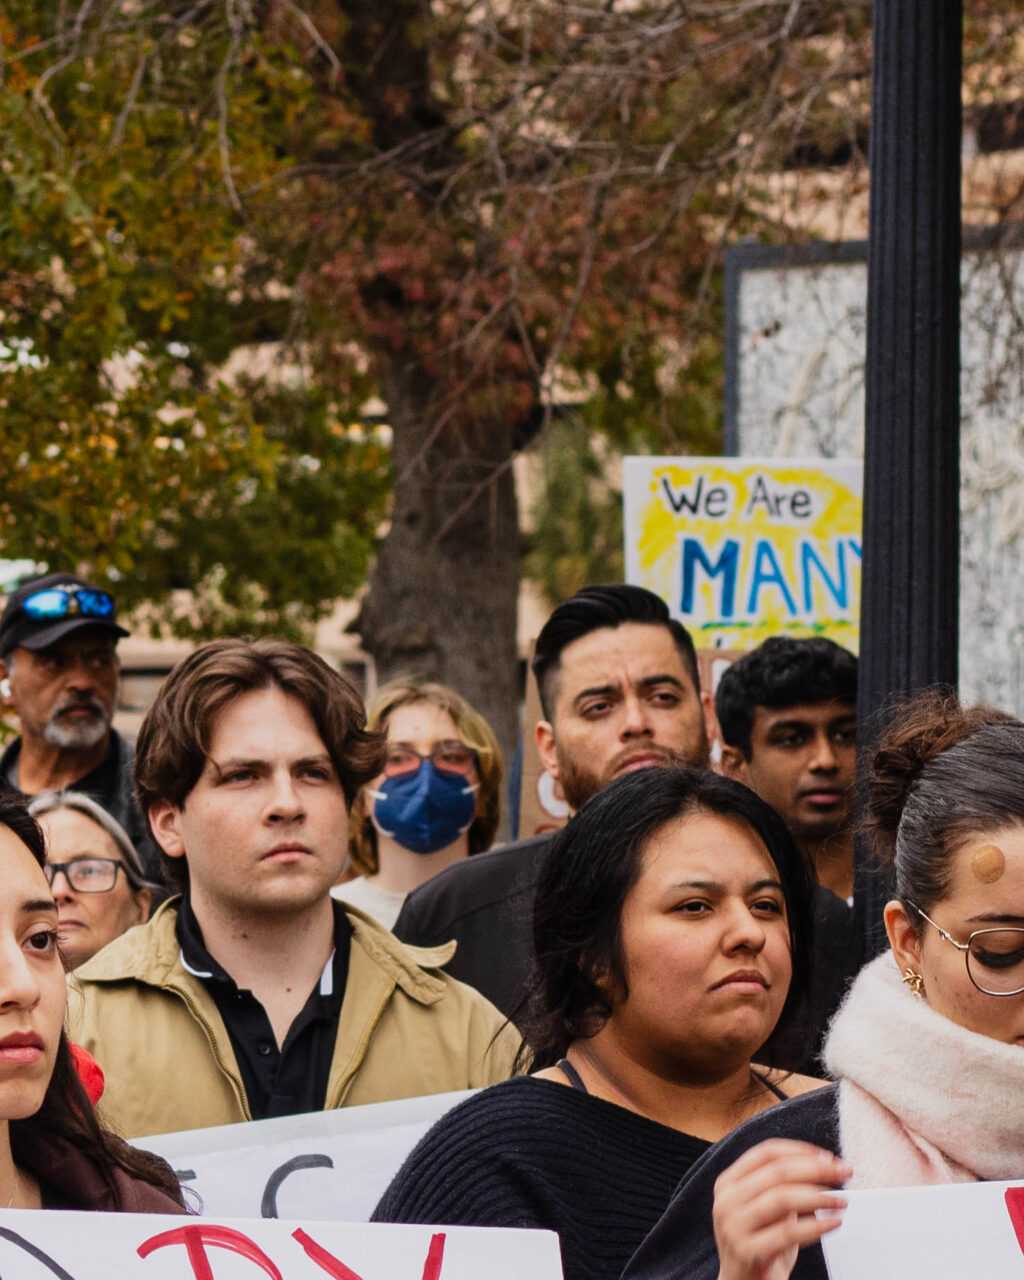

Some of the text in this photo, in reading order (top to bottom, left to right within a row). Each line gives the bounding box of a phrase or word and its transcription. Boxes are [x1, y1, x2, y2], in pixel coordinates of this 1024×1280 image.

[661, 476, 812, 519] We Are
[680, 537, 862, 618] MAN
